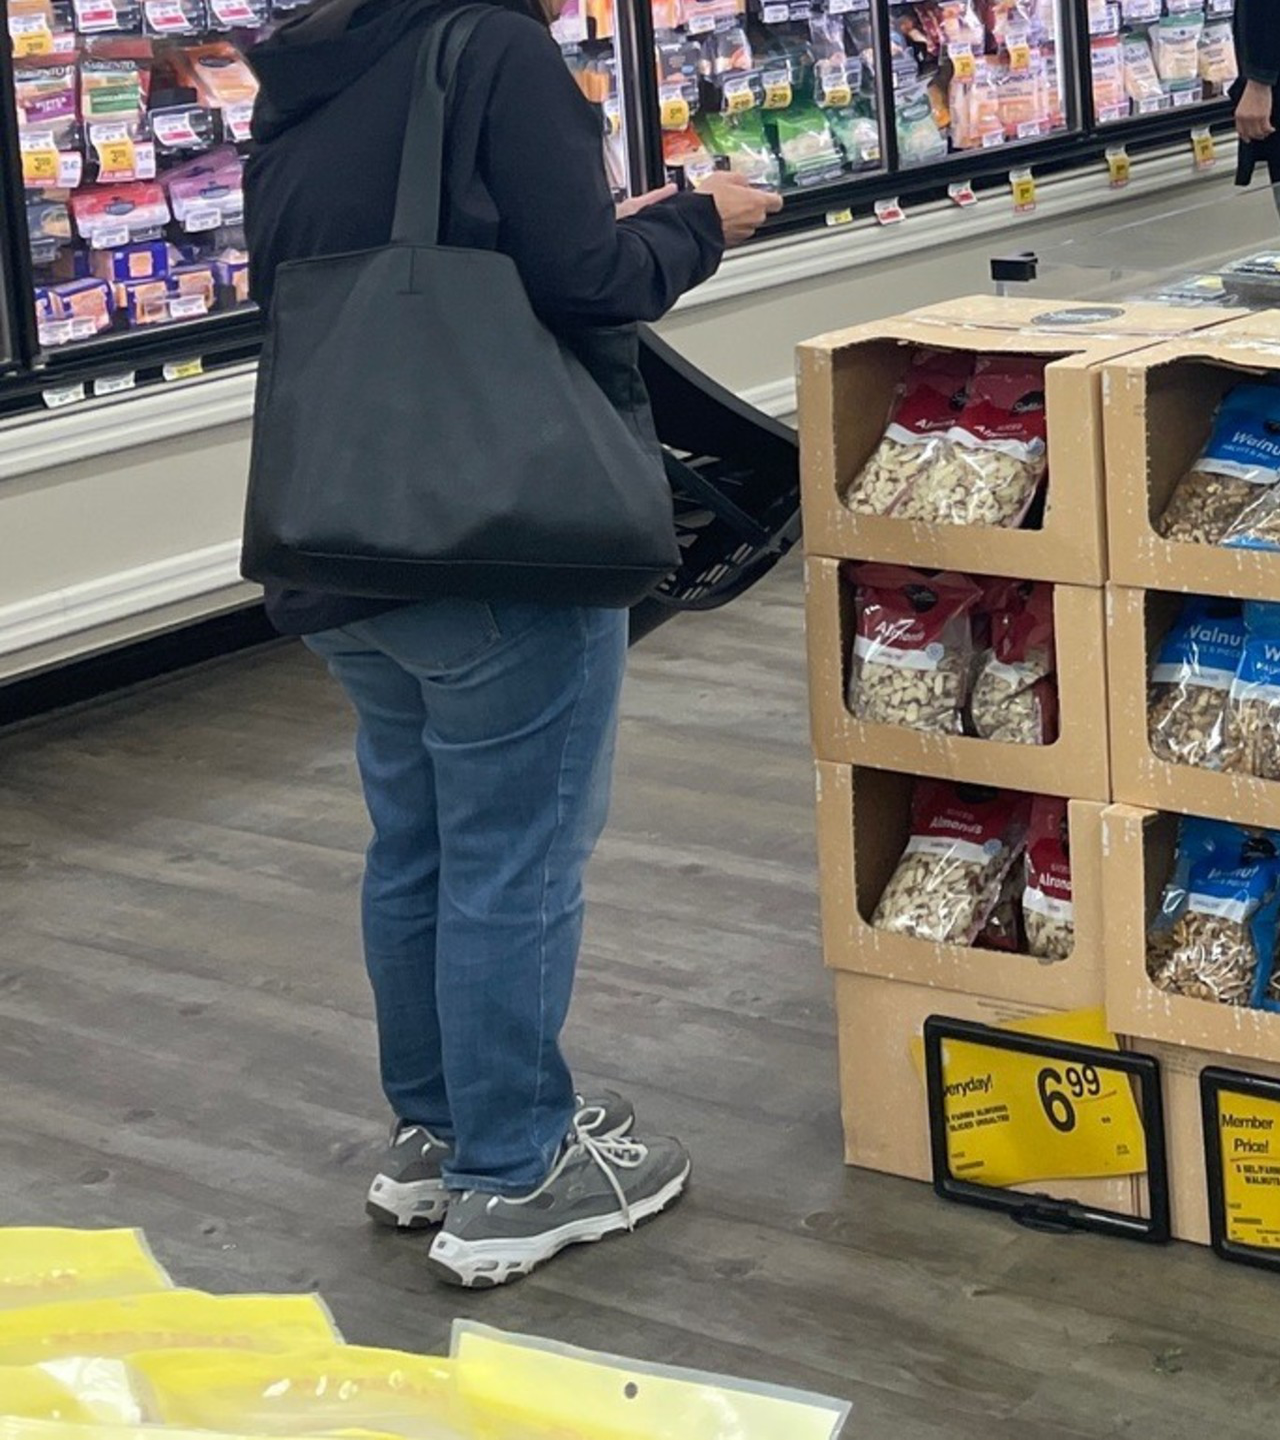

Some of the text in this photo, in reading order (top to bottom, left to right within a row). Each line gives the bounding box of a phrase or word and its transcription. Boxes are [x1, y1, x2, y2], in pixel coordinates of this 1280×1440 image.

[929, 816, 983, 835] Almonds
[1221, 1114, 1274, 1131] Member
[1233, 1138, 1269, 1154] Price!
